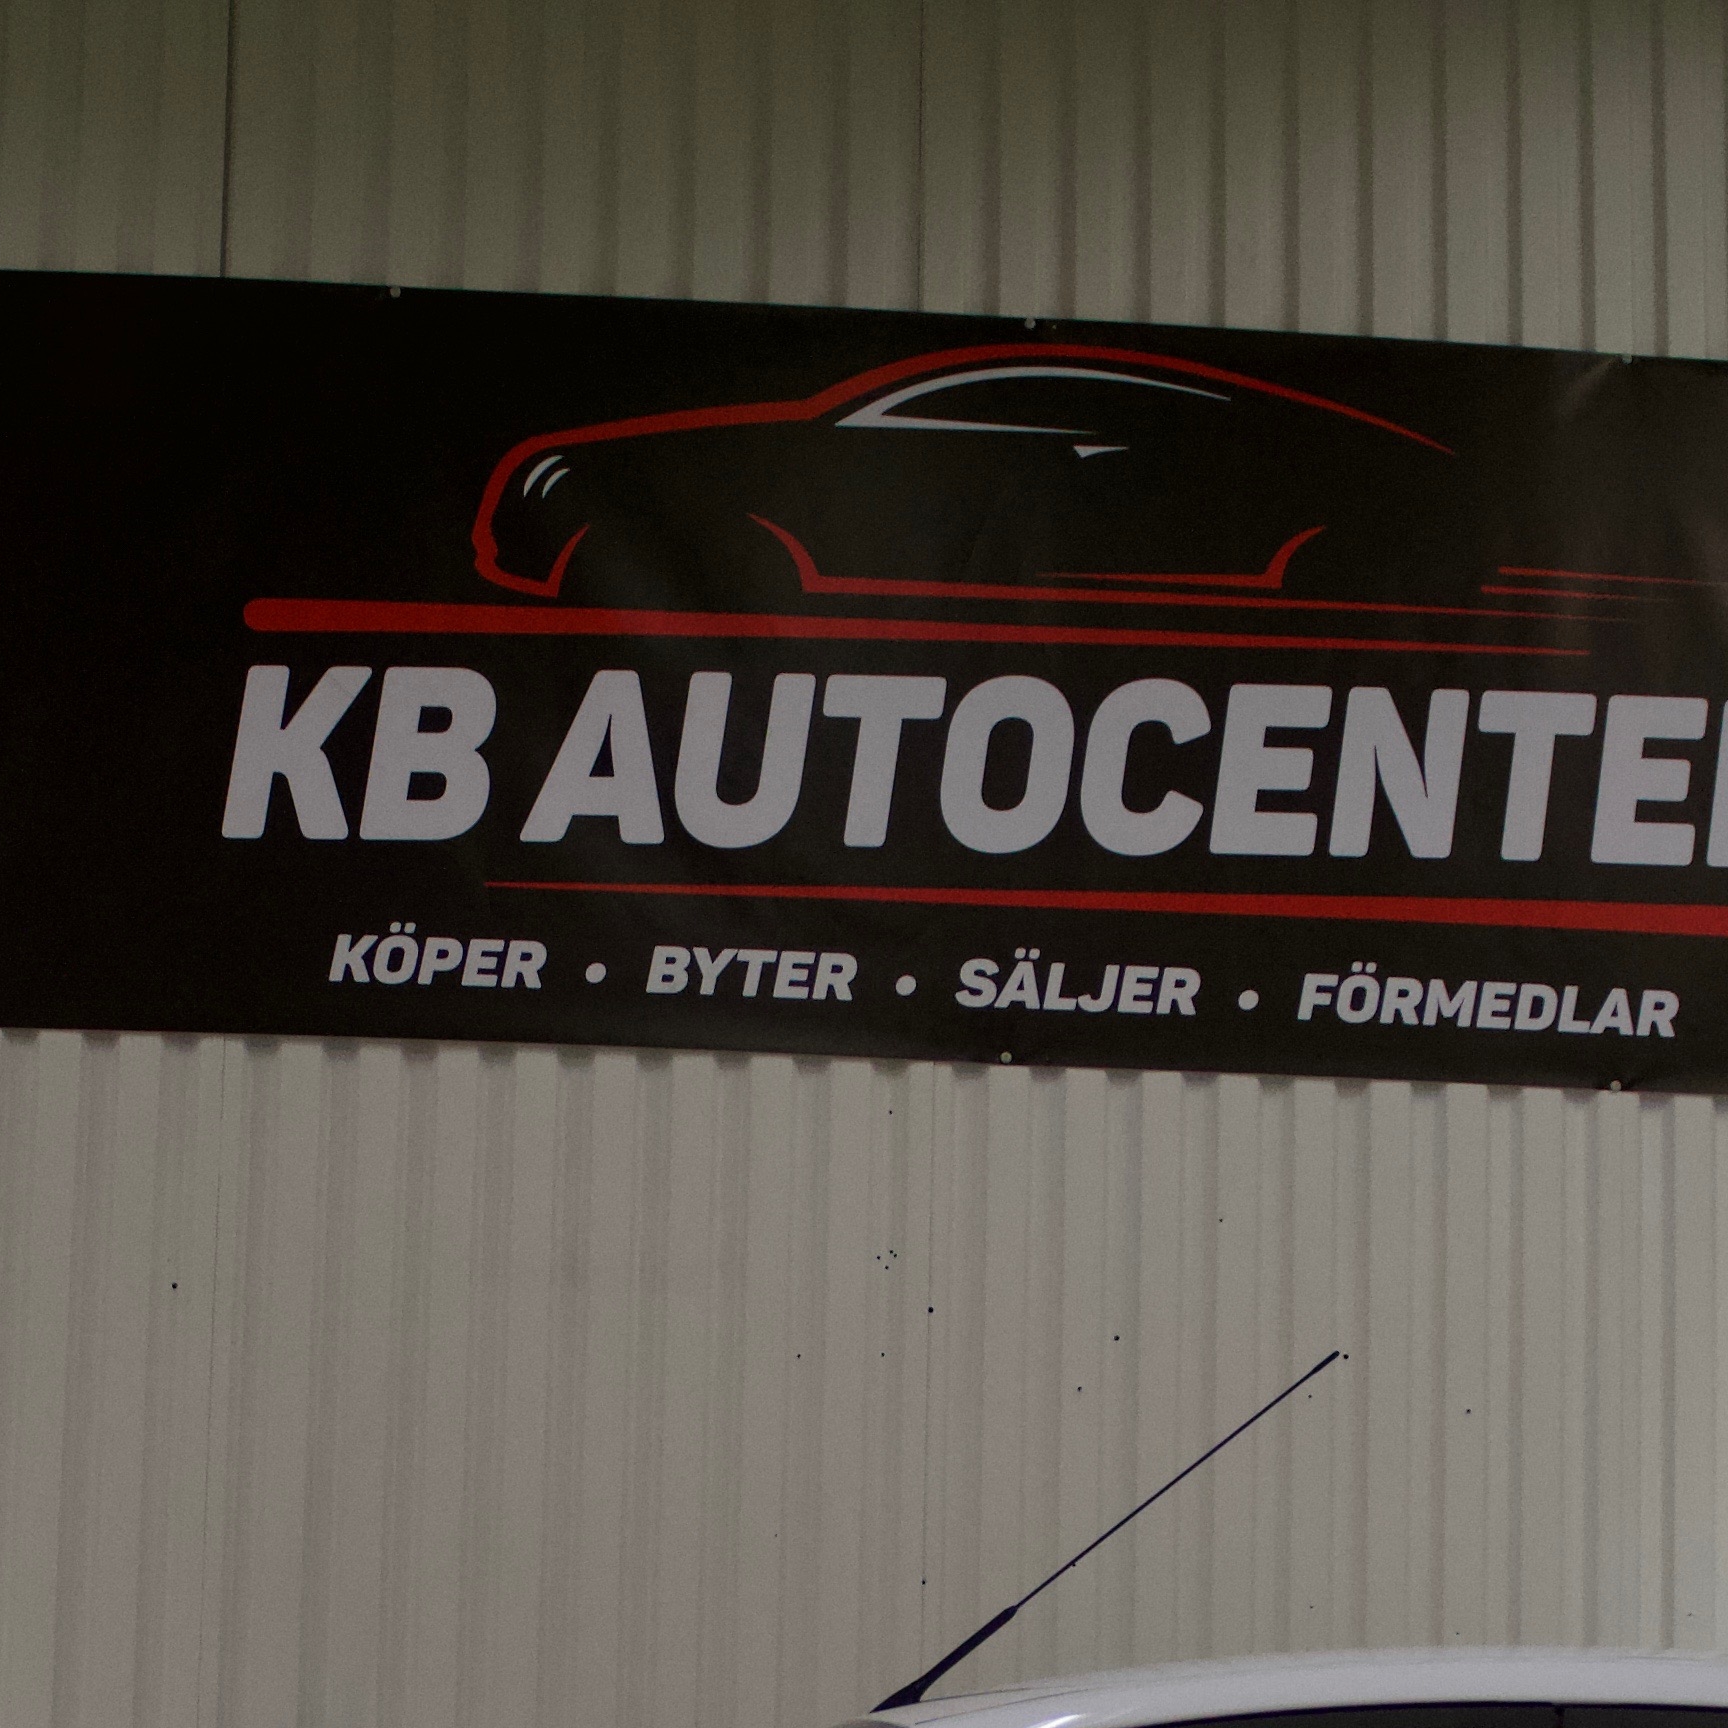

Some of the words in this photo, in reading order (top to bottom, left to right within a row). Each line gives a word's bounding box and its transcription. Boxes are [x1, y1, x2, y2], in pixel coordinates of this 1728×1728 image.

[221, 664, 497, 841] KB
[328, 921, 548, 989] KÖPER
[645, 945, 858, 1002] BYTER
[954, 947, 1201, 1016] SÄLJER
[1297, 961, 1680, 1038] FÖRMEDLAR
